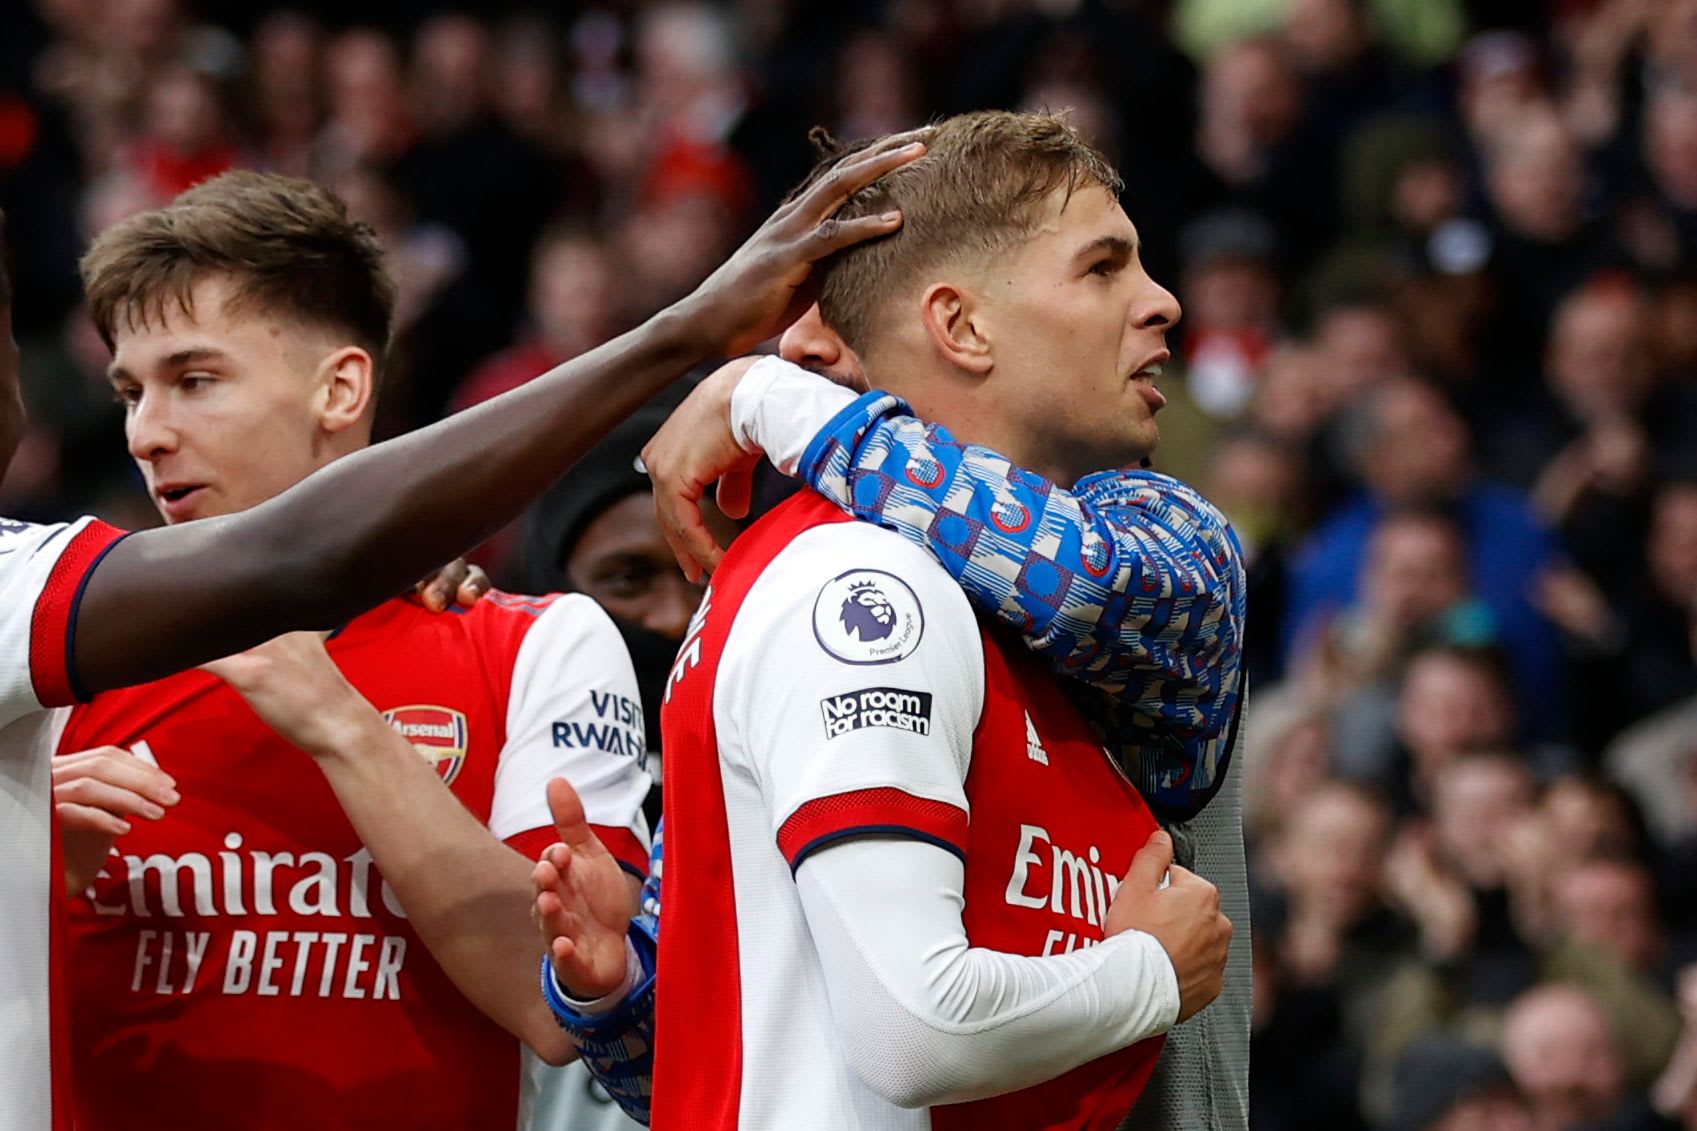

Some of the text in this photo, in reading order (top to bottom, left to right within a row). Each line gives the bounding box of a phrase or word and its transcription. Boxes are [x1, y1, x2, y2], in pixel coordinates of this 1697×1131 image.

[869, 612, 915, 657] Premier League
[821, 690, 921, 721] No room
[824, 709, 929, 740] for racism
[131, 930, 408, 1000] FLY BETTER
